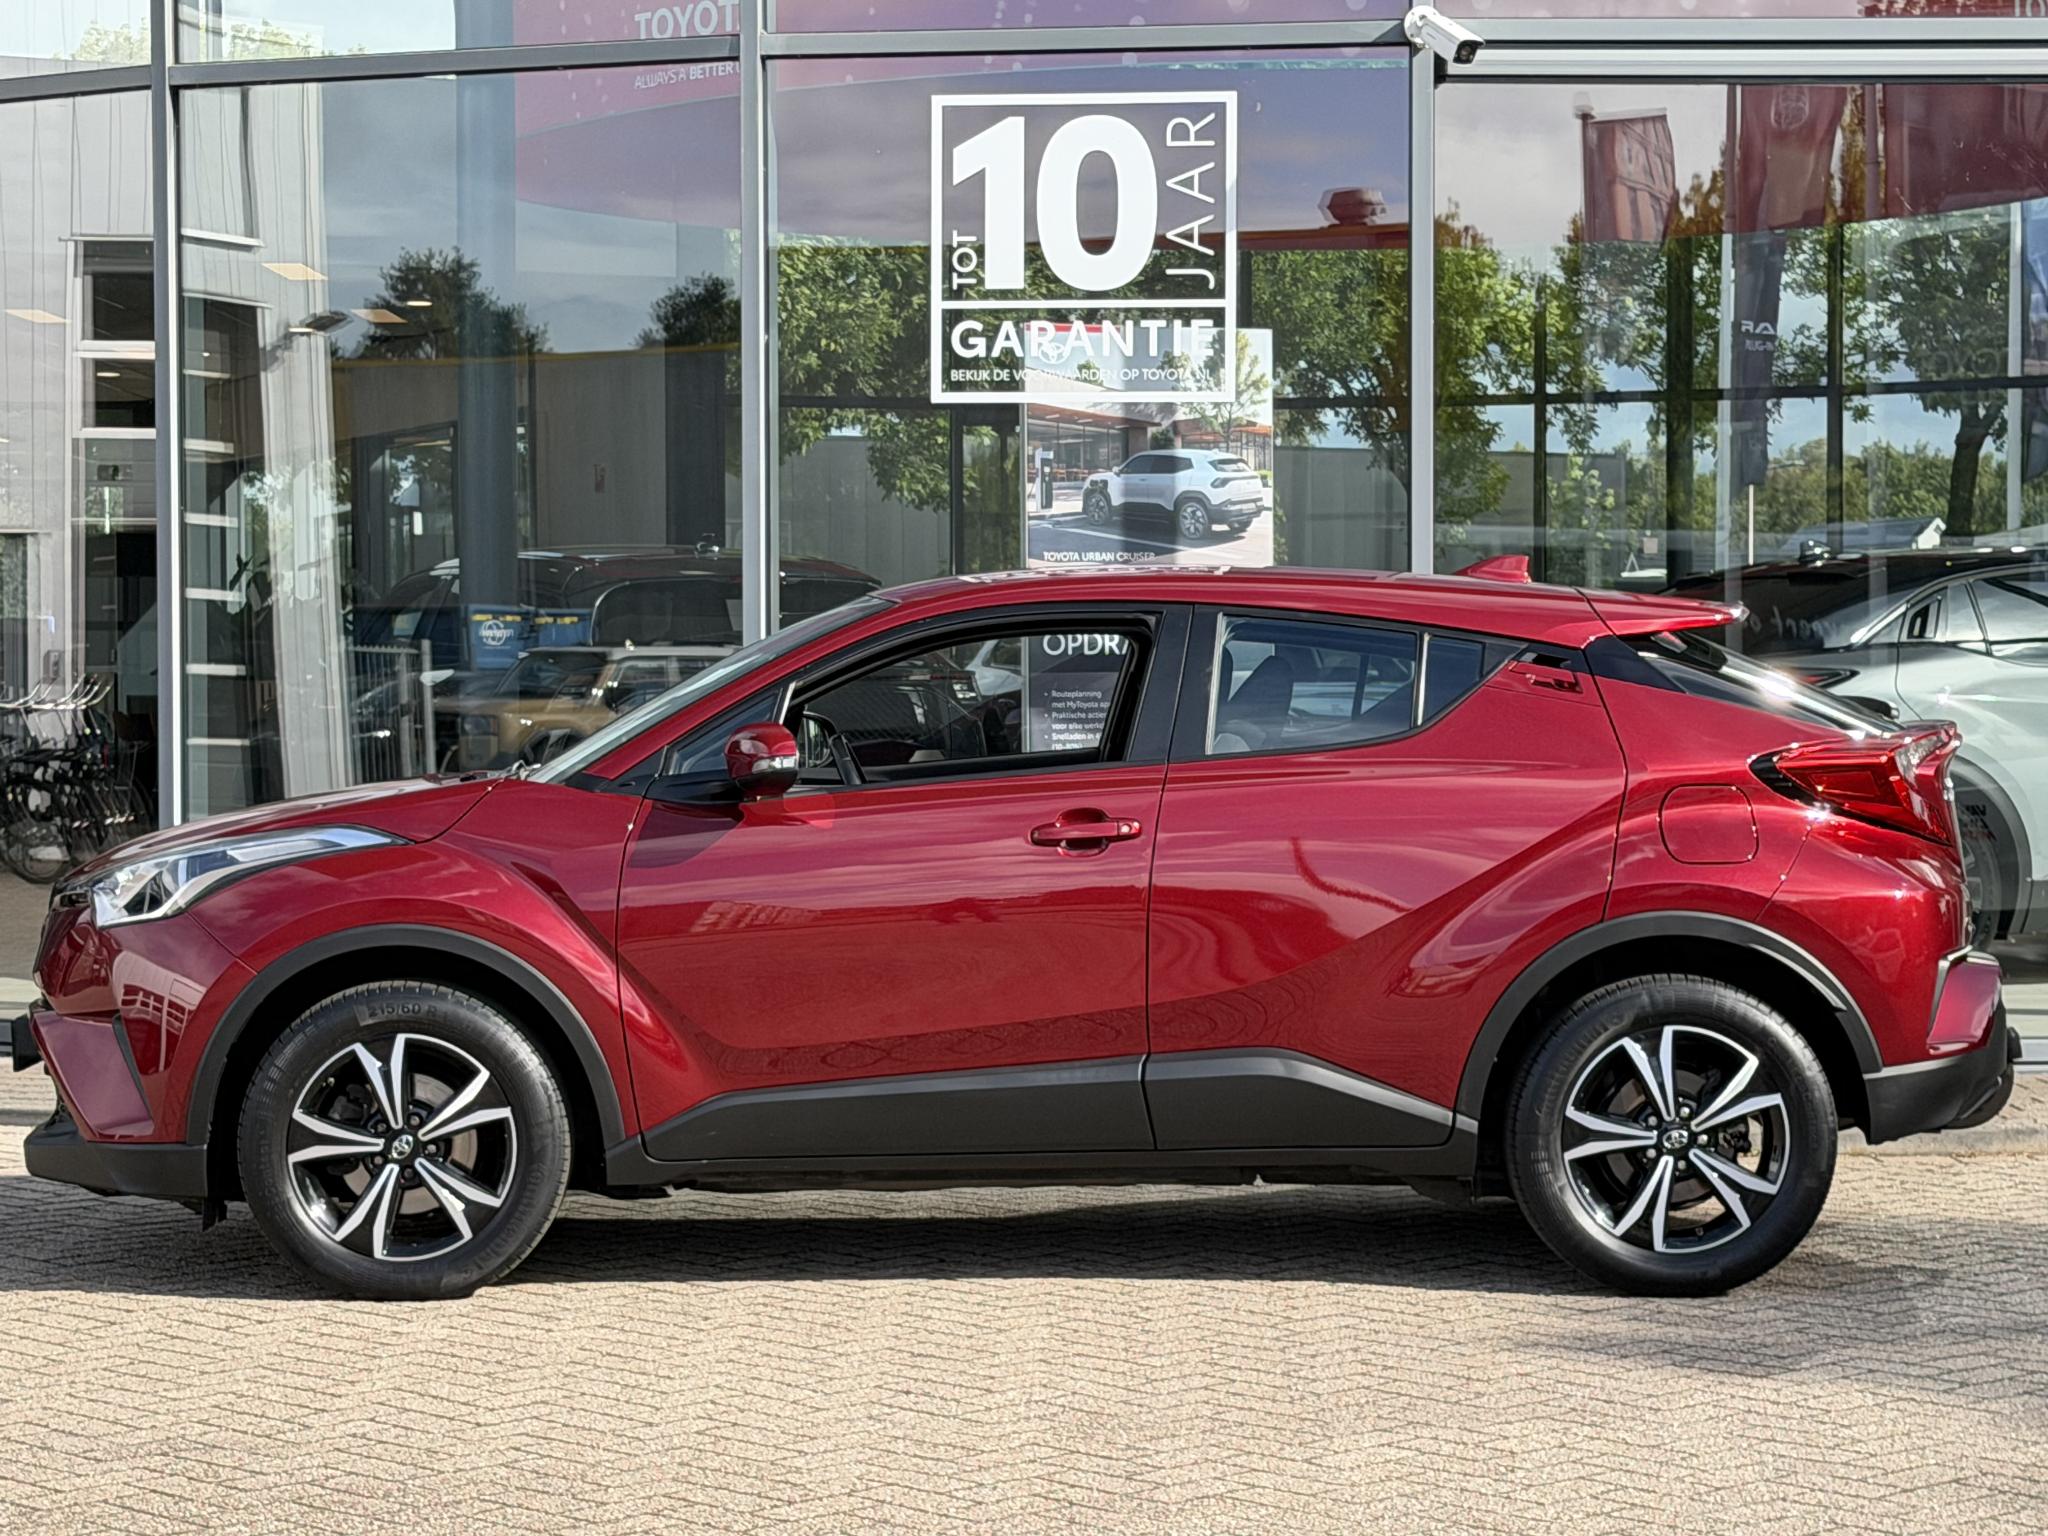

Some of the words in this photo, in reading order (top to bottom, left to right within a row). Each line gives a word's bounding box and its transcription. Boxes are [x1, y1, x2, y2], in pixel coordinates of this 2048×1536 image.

[634, 0, 740, 40] TOYOT
[634, 70, 677, 89] ALWAYS
[678, 69, 687, 81] A
[689, 62, 733, 80] BETTER
[952, 114, 1158, 292] 10
[1165, 112, 1216, 290] JAAR
[952, 229, 978, 291] TOT
[950, 319, 1215, 359] GARANTIE
[950, 369, 991, 381] BEKIJK
[993, 369, 1011, 381] DE
[1119, 368, 1140, 381] OP
[1141, 368, 1213, 381] TOYOTANL
[1043, 551, 1079, 562] TOYOTA
[1081, 551, 1115, 561] URBAN
[1116, 551, 1156, 561] CRUISER
[1051, 690, 1103, 699] Routeplanning
[1051, 711, 1086, 719] Praktische
[1066, 701, 1099, 710] MyToyota
[1051, 733, 1087, 741] Snelladen
